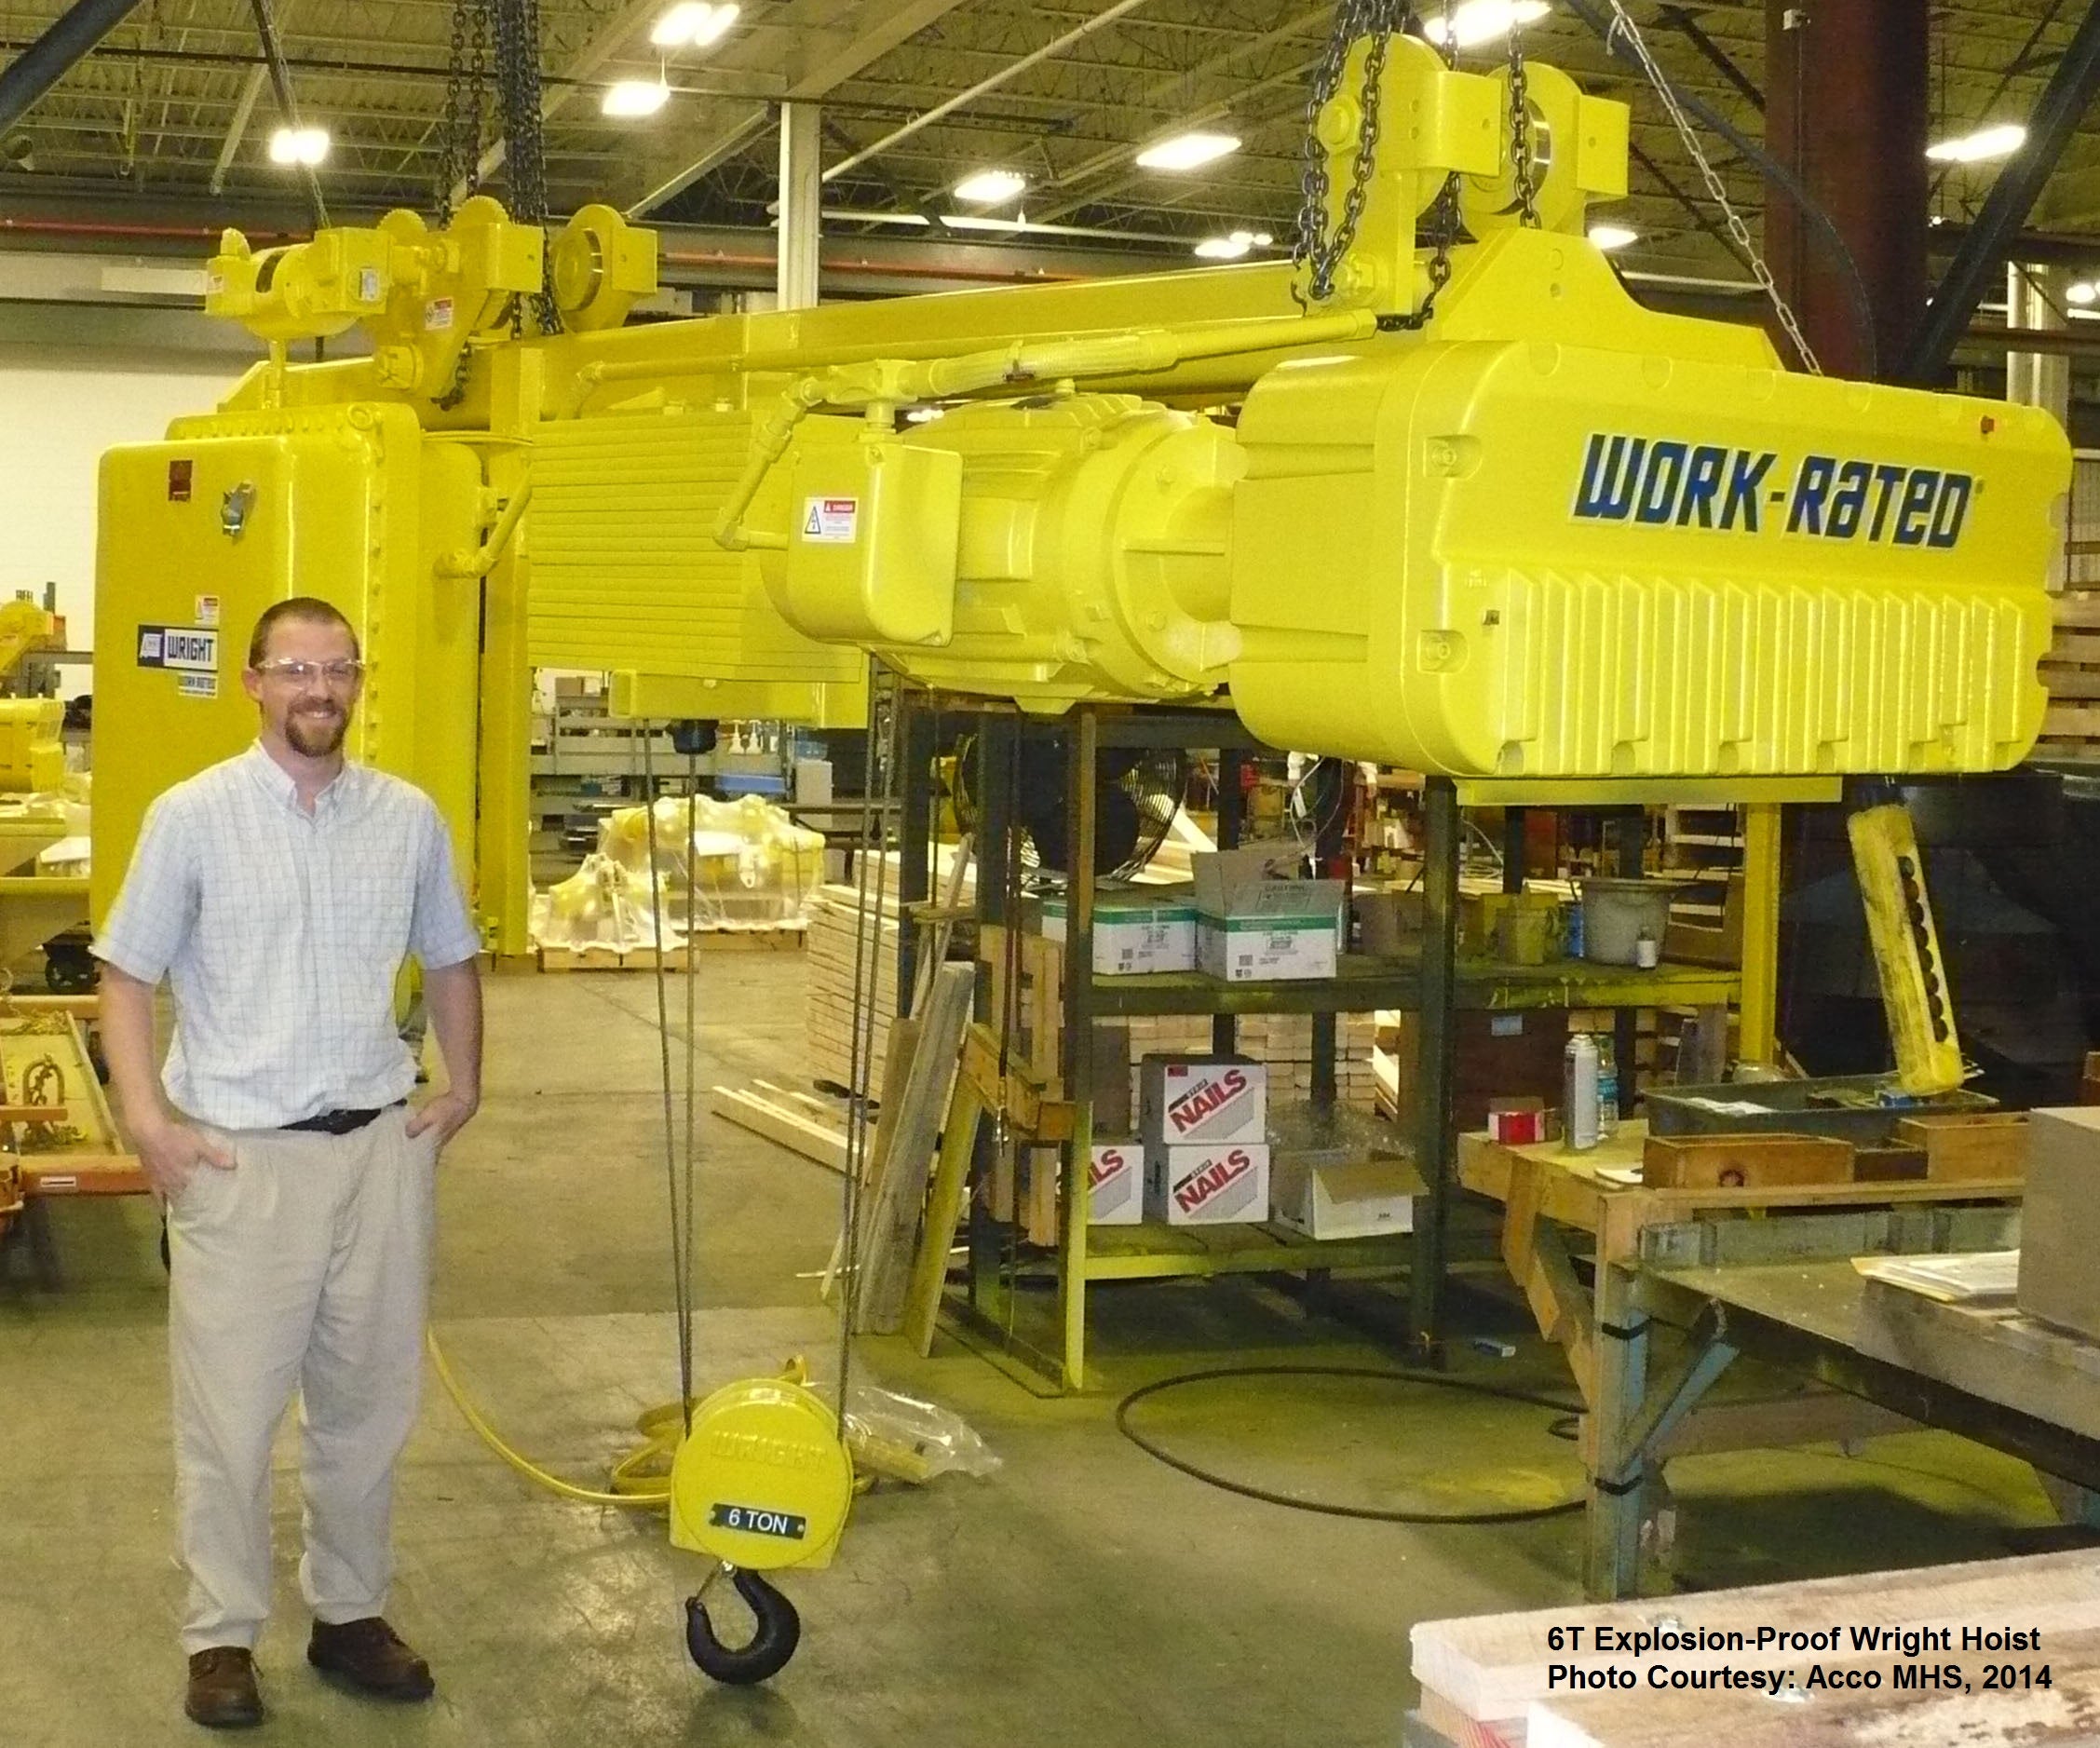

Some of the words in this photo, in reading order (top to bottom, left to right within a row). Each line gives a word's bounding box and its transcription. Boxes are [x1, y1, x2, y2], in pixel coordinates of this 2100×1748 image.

[168, 635, 213, 662] WRIGHT
[1170, 1069, 1246, 1133] NAILS
[1088, 1149, 1124, 1190] ILS
[1174, 1149, 1250, 1213] NAILS
[728, 1508, 740, 1525] 6
[747, 1511, 788, 1534] TON
